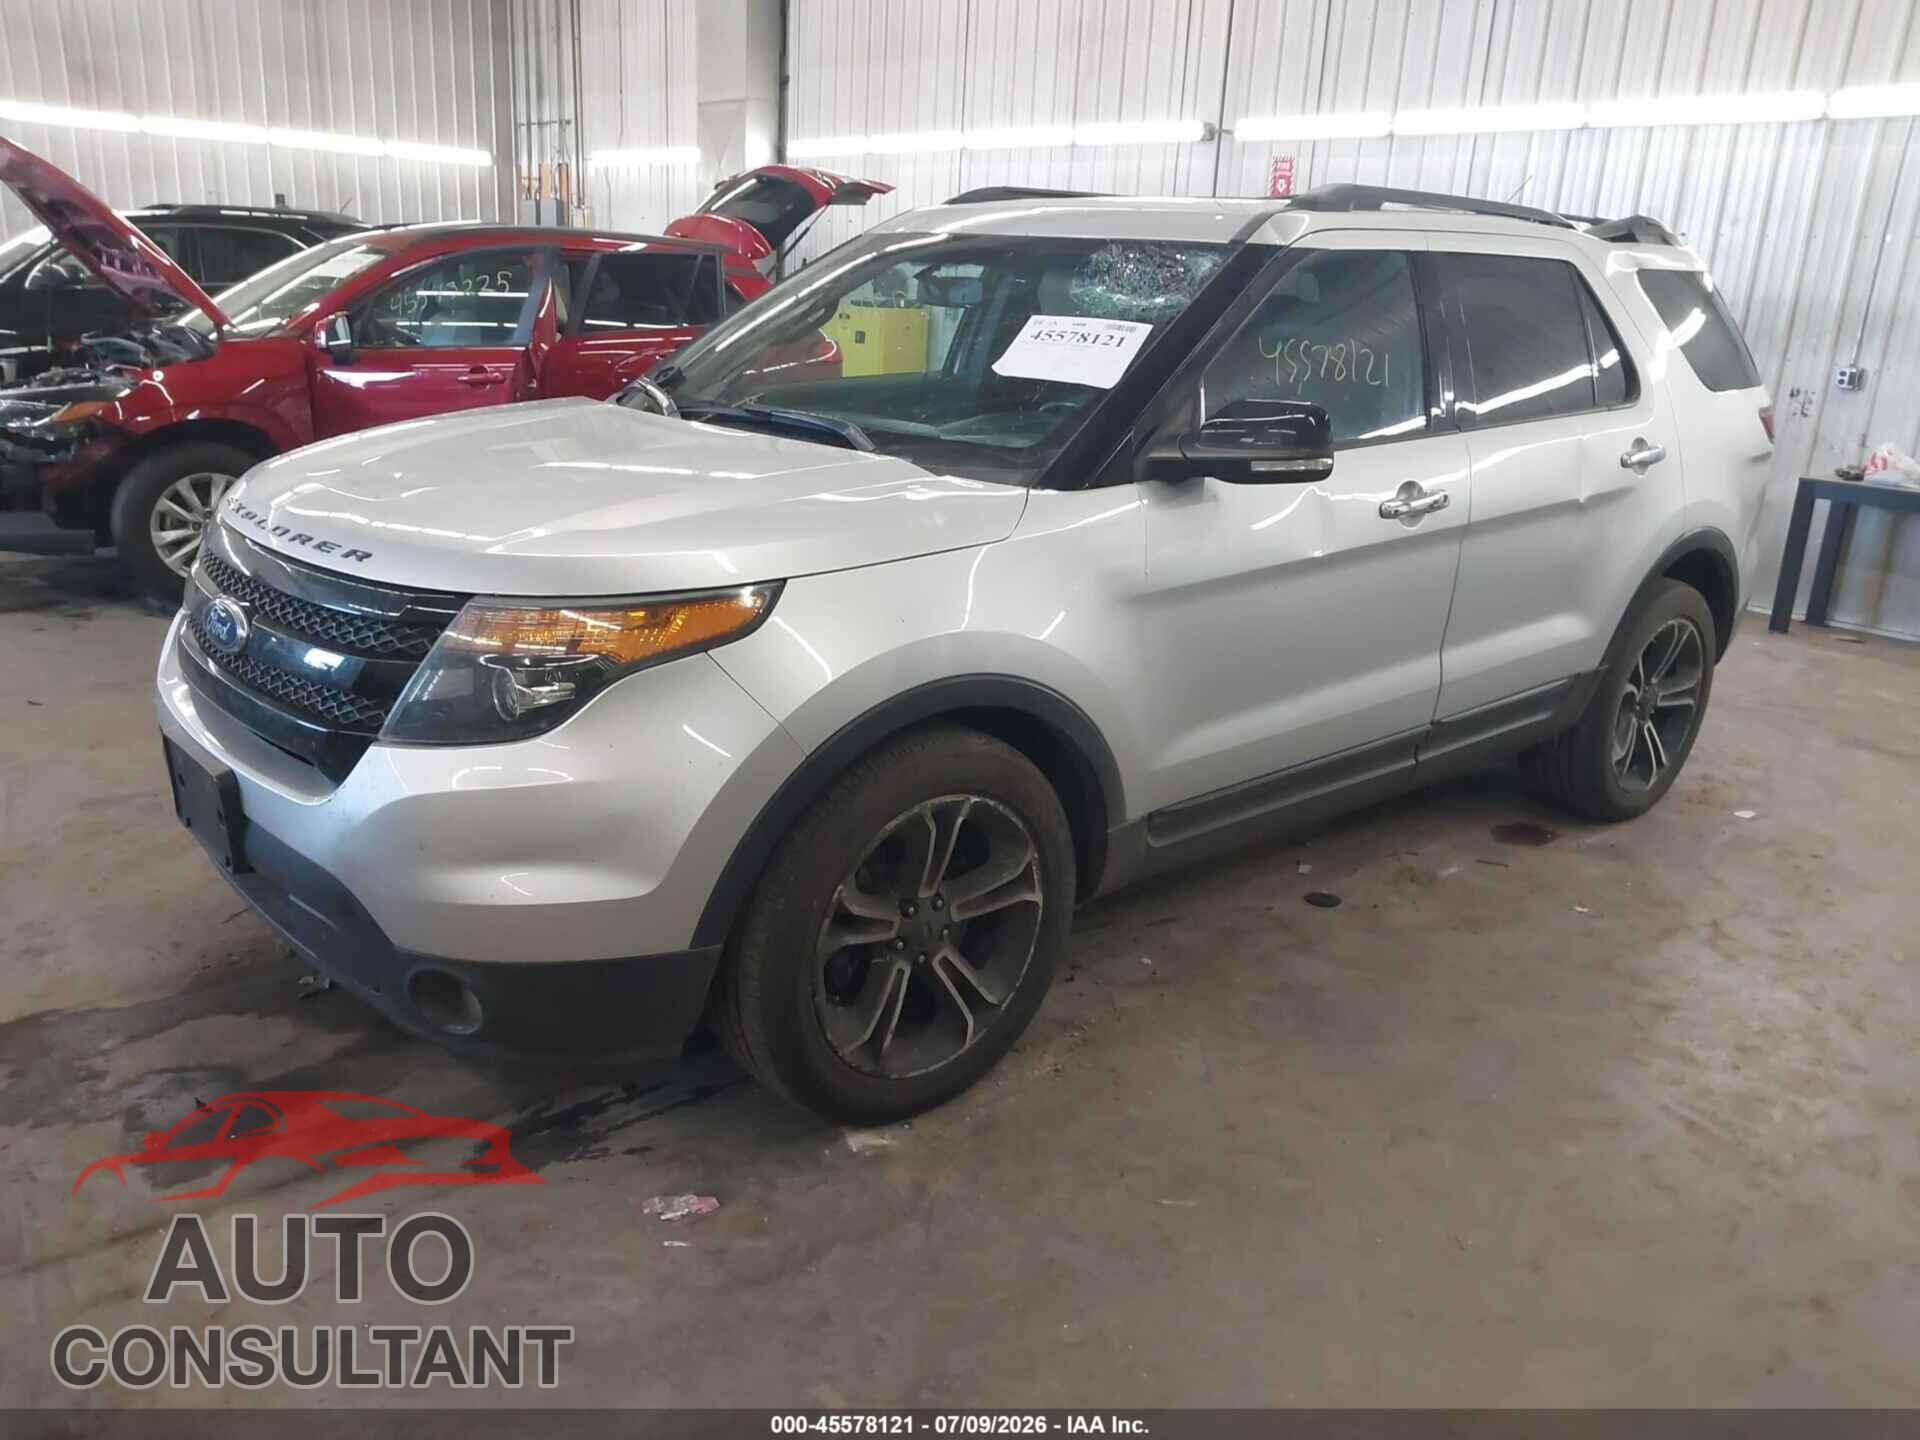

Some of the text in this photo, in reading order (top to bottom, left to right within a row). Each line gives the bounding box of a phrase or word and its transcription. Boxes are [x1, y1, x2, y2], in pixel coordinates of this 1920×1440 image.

[1030, 329, 1126, 348] 45578121
[1258, 336, 1390, 392] 45578121
[207, 606, 232, 640] Ford
